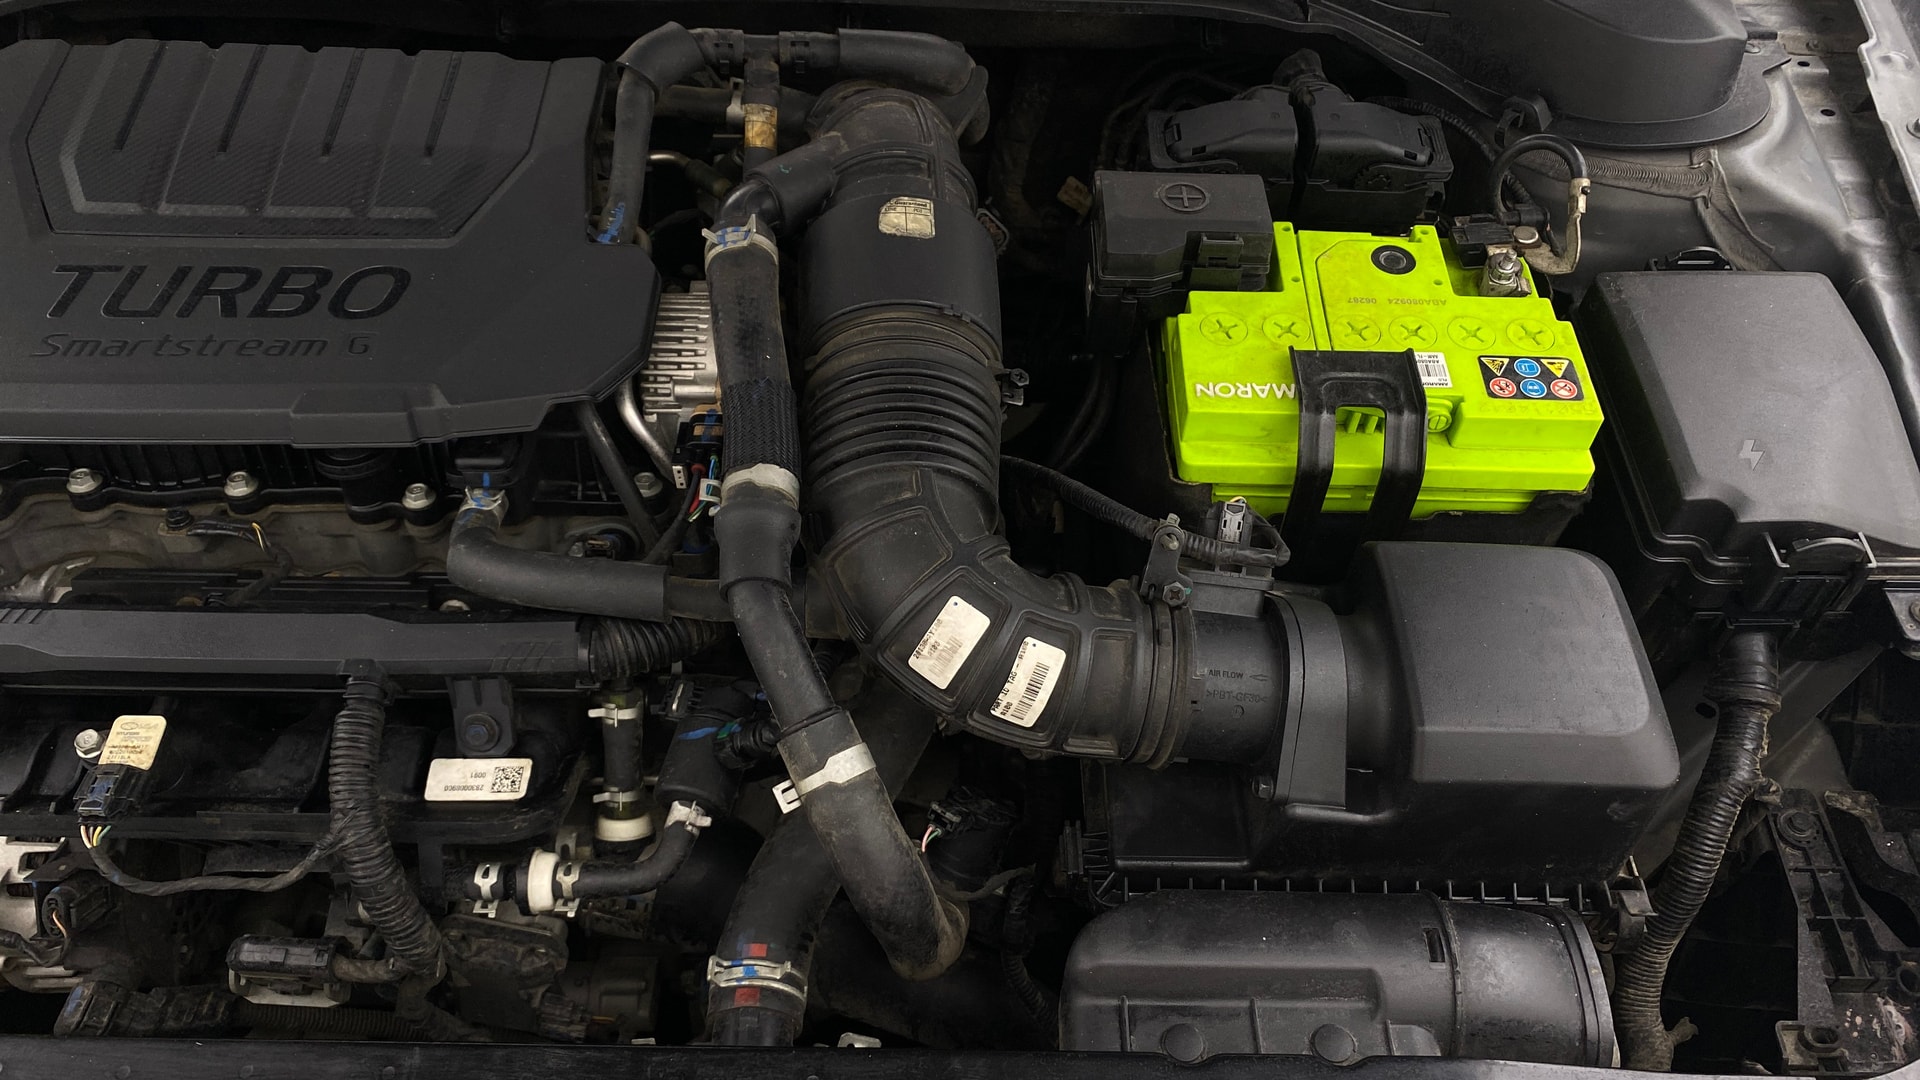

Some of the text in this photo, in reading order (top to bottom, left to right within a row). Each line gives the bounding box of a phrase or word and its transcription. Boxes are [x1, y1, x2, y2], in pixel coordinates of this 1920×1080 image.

[45, 264, 412, 319] TURBO
[30, 333, 371, 359] Smartstream G
[1195, 382, 1296, 399] MARON
[1208, 669, 1244, 679] AIR FLOW
